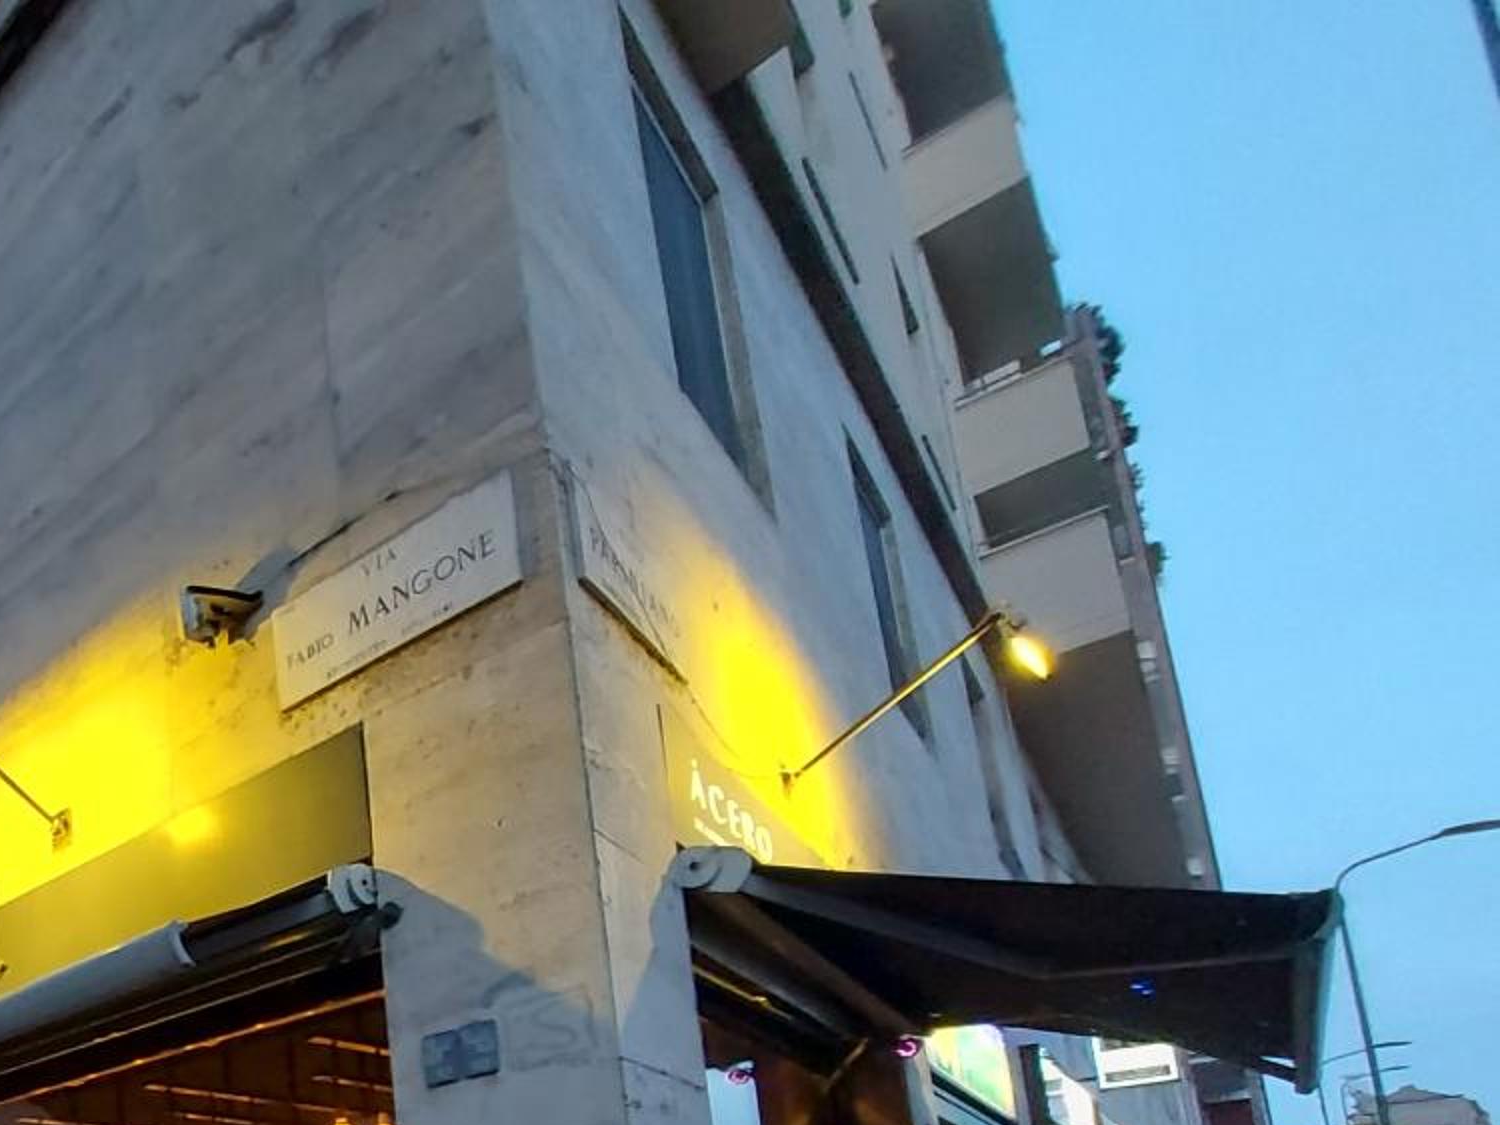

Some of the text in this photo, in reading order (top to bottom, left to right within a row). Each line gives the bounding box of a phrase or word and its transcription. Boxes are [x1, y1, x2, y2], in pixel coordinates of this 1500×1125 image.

[285, 632, 335, 670] FABIO
[347, 529, 497, 636] MANGONE
[361, 547, 398, 577] VIA
